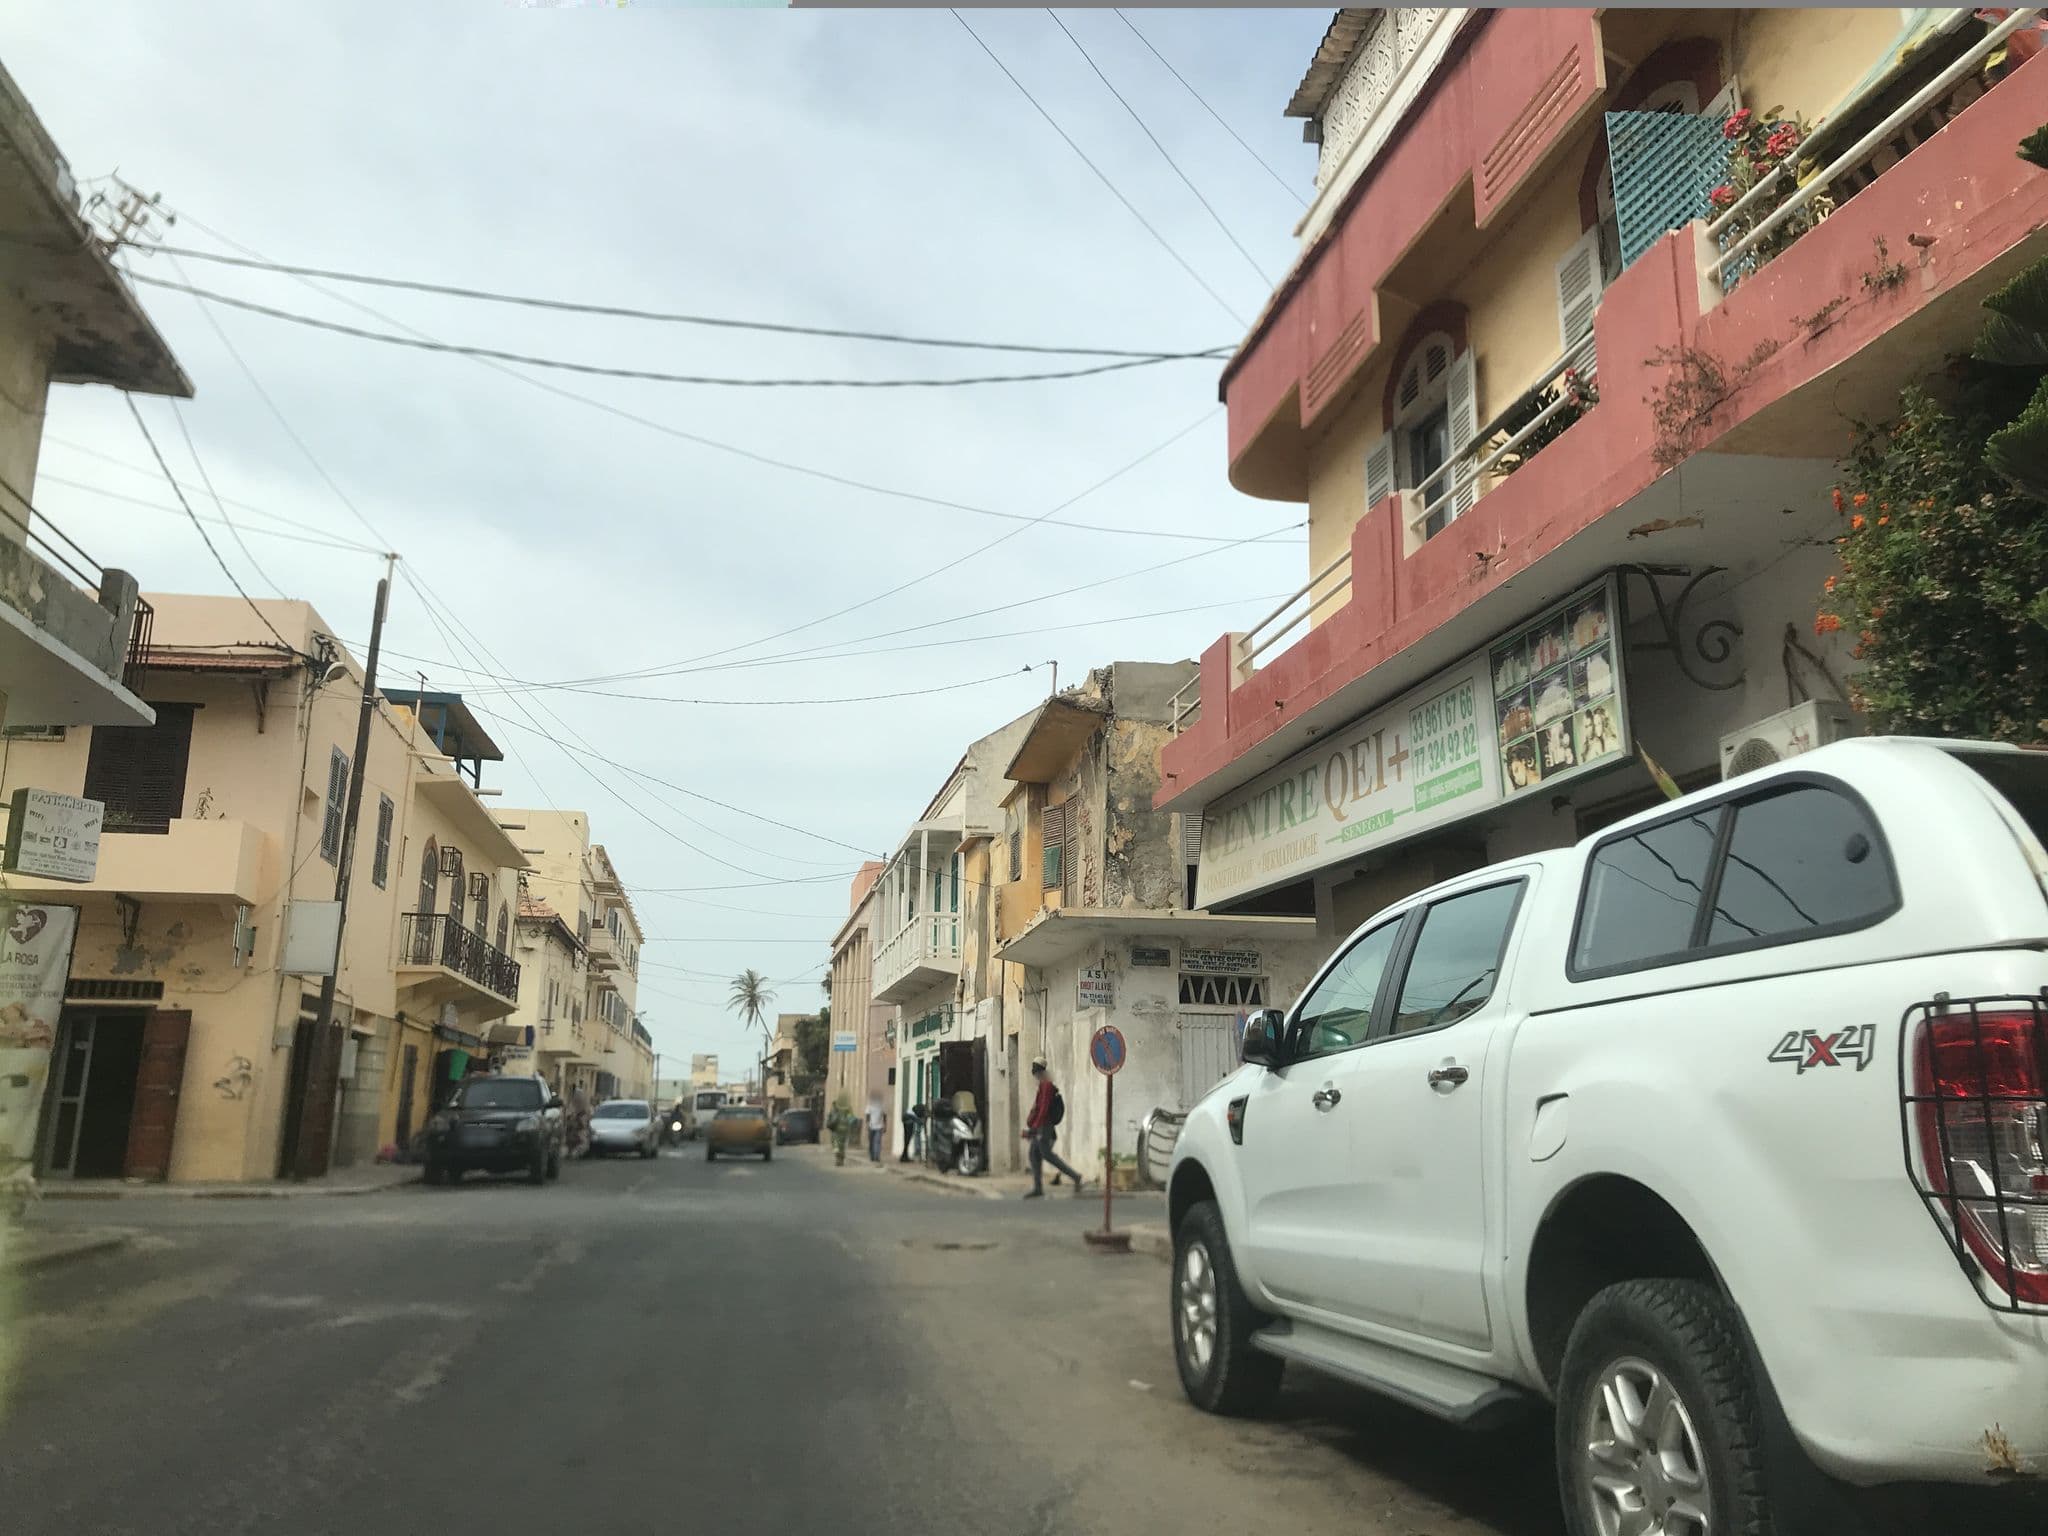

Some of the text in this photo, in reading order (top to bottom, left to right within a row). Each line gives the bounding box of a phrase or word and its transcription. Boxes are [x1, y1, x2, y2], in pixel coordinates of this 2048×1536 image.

[1413, 685, 1473, 743] 33 961 67 66
[1414, 722, 1476, 778] 77 324 92 82
[1206, 764, 1320, 863] CENTRE
[1342, 812, 1389, 842] SENEGAL
[15, 952, 39, 966] ROSA
